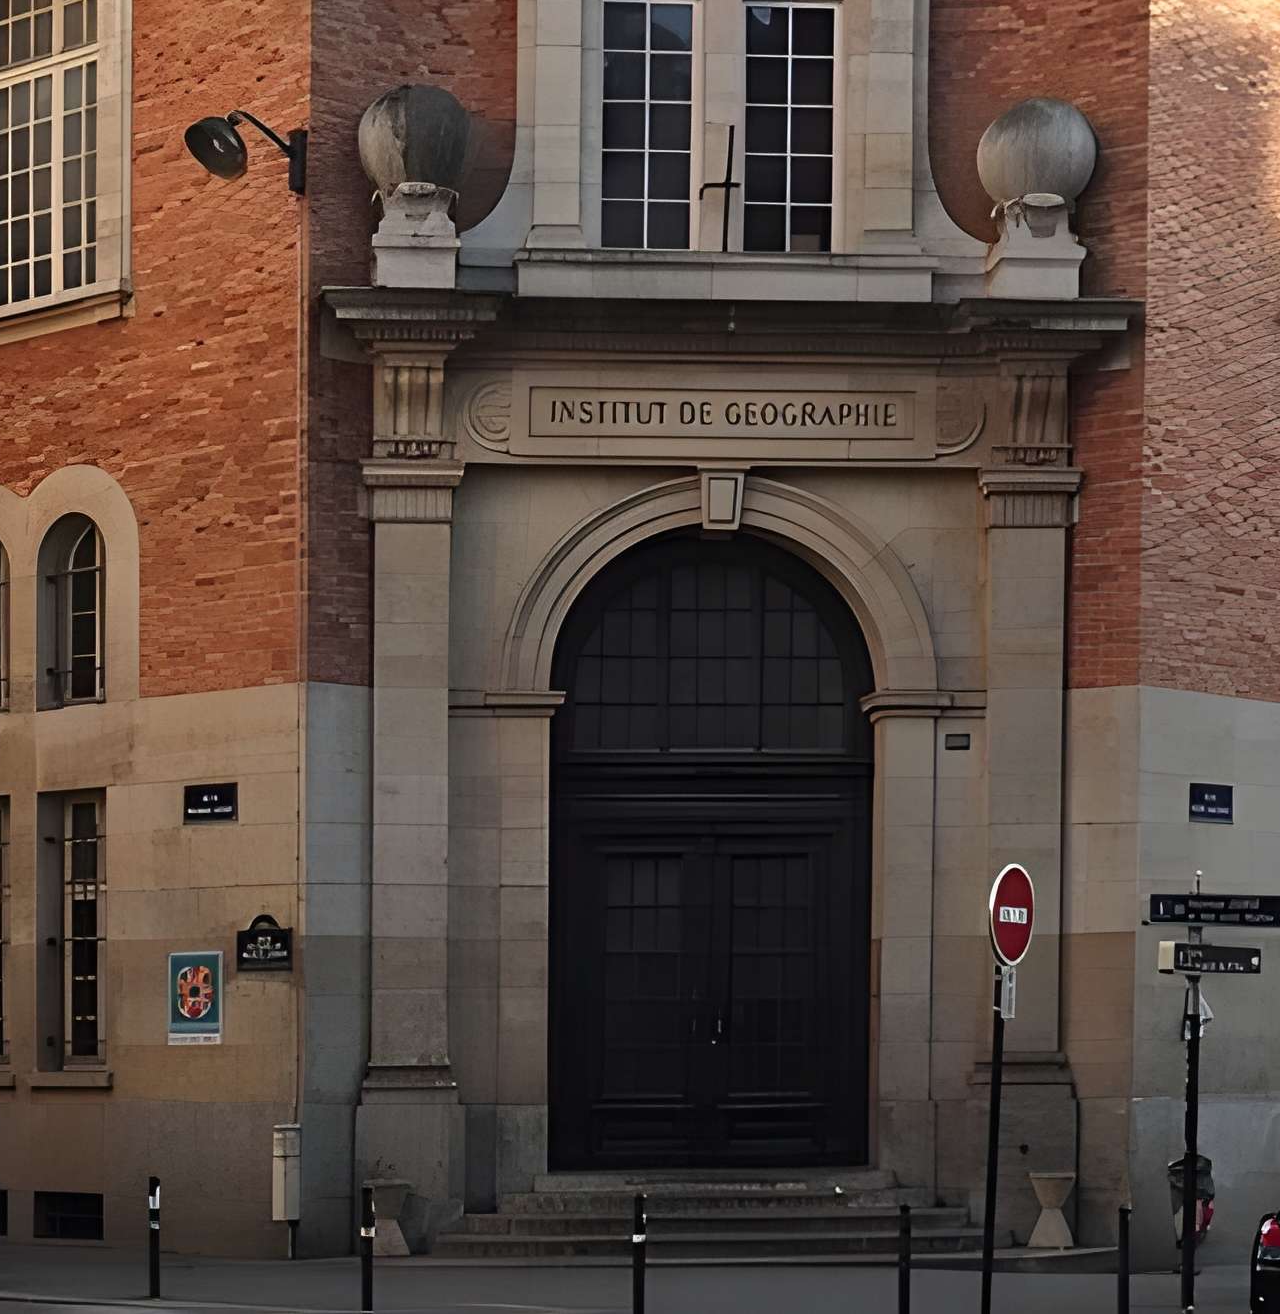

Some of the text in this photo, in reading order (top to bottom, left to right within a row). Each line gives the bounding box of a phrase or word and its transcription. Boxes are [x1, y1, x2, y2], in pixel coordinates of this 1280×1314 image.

[550, 399, 897, 427] INSTITUT DE GEOGRAPHIE
